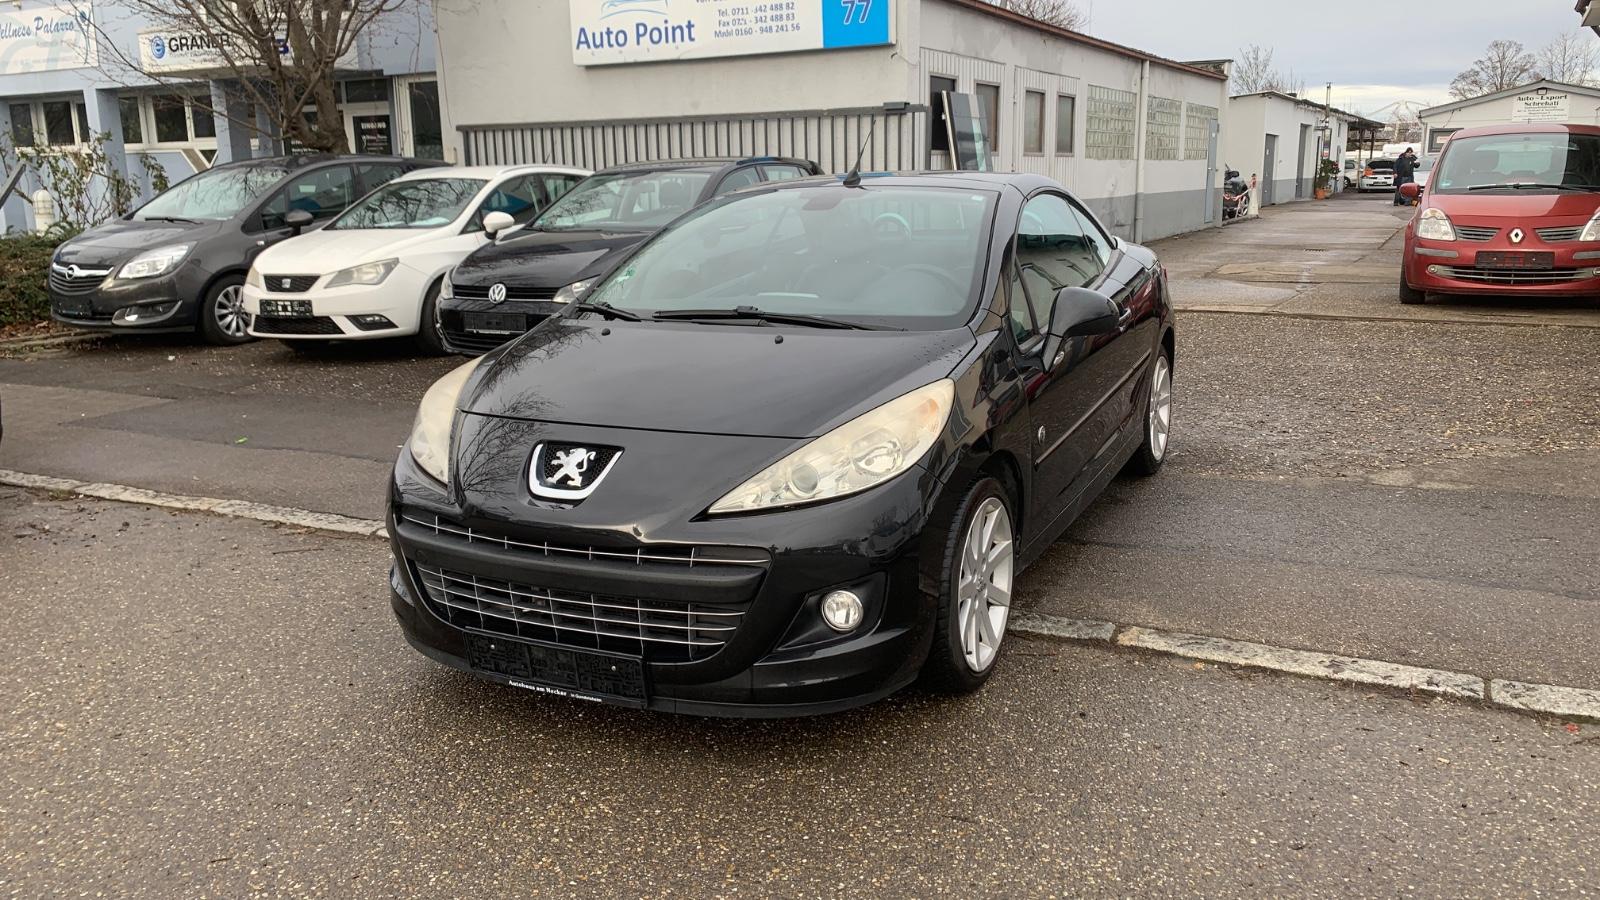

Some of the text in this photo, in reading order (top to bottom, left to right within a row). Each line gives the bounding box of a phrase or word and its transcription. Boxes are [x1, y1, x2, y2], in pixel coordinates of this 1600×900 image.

[732, 6, 749, 16] 0711
[769, 3, 783, 12] 488
[784, 2, 795, 11] 82
[718, 19, 730, 27] Fax
[753, 15, 768, 24] 342
[769, 14, 784, 23] 488
[785, 13, 795, 22] 83
[0, 23, 31, 39] ellness
[576, 19, 695, 50] Auto Point
[734, 27, 753, 36] 0160
[759, 26, 773, 35] 948
[775, 24, 789, 33] 241
[791, 23, 801, 32] 56
[509, 680, 535, 690] Autohaus
